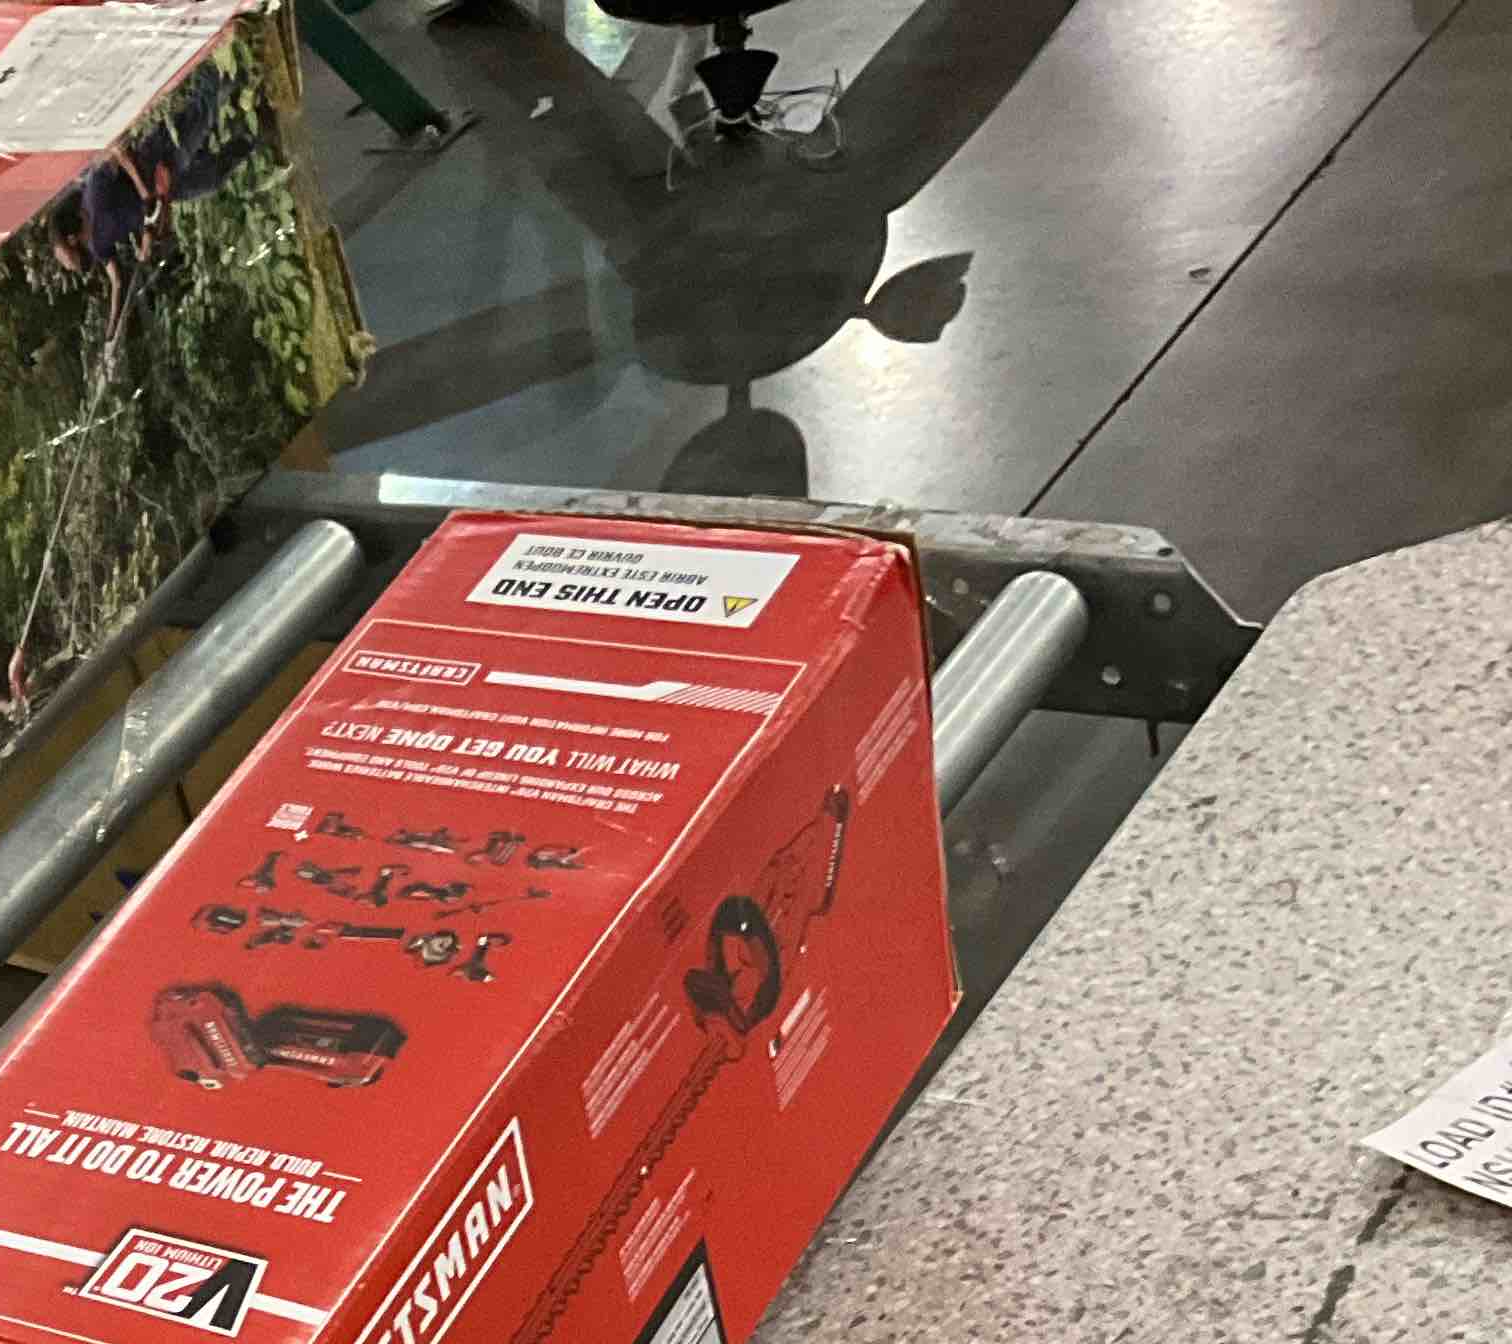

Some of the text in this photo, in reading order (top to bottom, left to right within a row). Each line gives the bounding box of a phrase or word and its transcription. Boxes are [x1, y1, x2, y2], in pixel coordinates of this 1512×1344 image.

[521, 543, 646, 564] OUVRIR CE BOUT
[617, 567, 710, 586] ABRIR ESTE
[487, 577, 710, 614] OPEN THIS END
[350, 654, 471, 679] CRAFTSMAN
[317, 719, 684, 780] WHAT WILL YOU GET DONE NEXT?
[43, 1131, 93, 1165] IT
[57, 1107, 324, 1177] BUILD. REPAIR. RESTORE. MAINTAIN.
[75, 1137, 138, 1175] DO
[1406, 1117, 1496, 1169] LOAD
[122, 1147, 181, 1184] TO
[163, 1156, 289, 1208] POWER
[272, 1180, 353, 1223] THE
[131, 1237, 225, 1269] LITHIUM ION
[96, 1249, 257, 1332] V20
